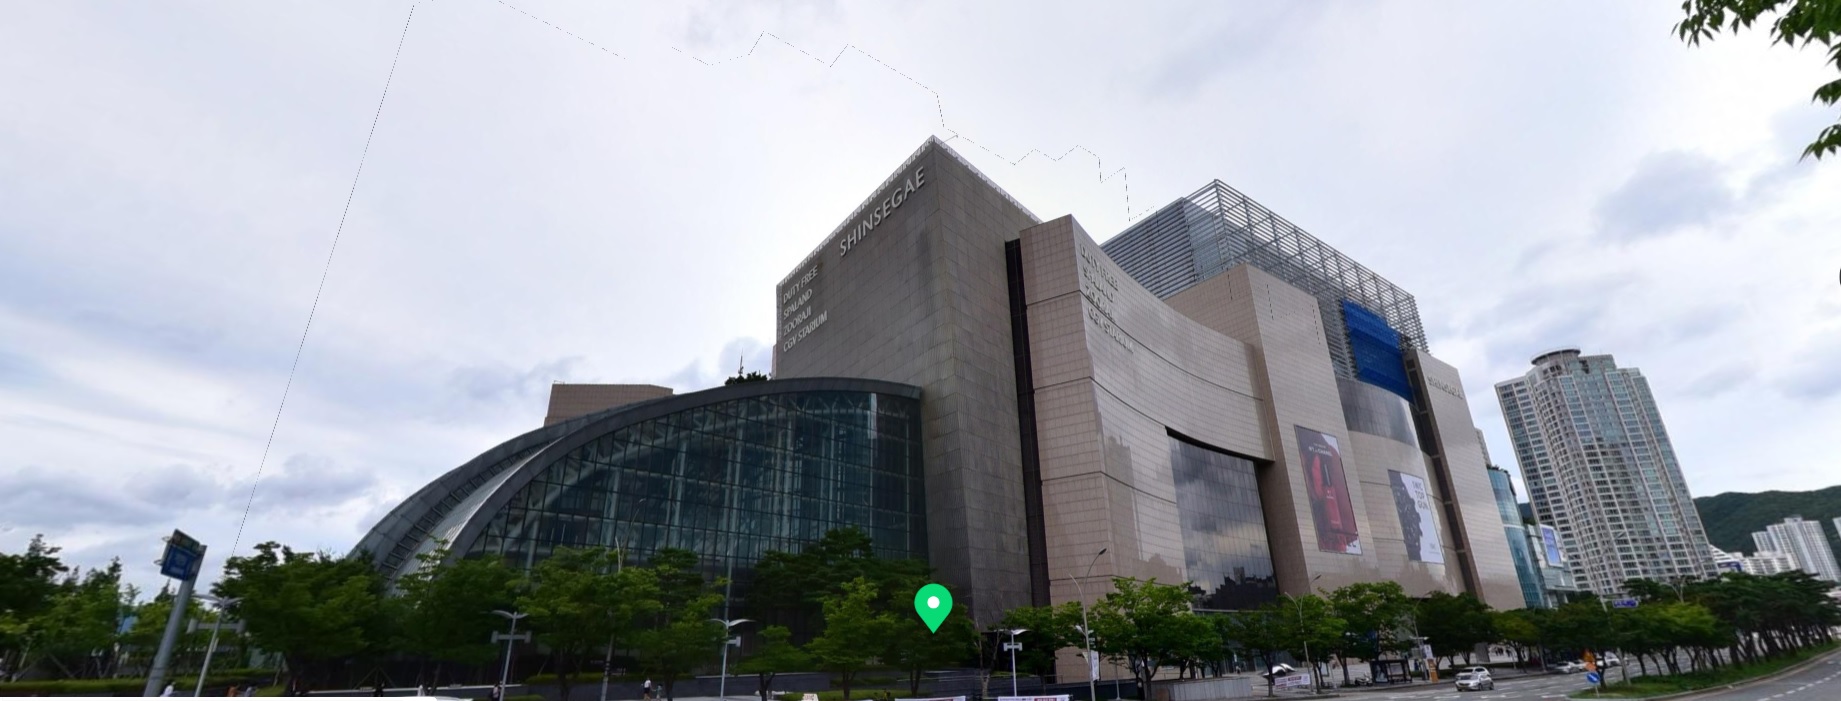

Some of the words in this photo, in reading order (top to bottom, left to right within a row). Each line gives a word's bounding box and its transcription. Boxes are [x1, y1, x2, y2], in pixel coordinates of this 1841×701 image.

[840, 166, 925, 256] SHINSEGAE
[783, 281, 801, 304] DUTY
[801, 265, 818, 287] FREE
[1100, 264, 1118, 291] FREE
[783, 289, 813, 320] SPALAND
[783, 305, 812, 336] ZOORAJI
[783, 334, 798, 352] CGV
[798, 310, 828, 342] STARIUM
[1414, 490, 1425, 499] TOP
